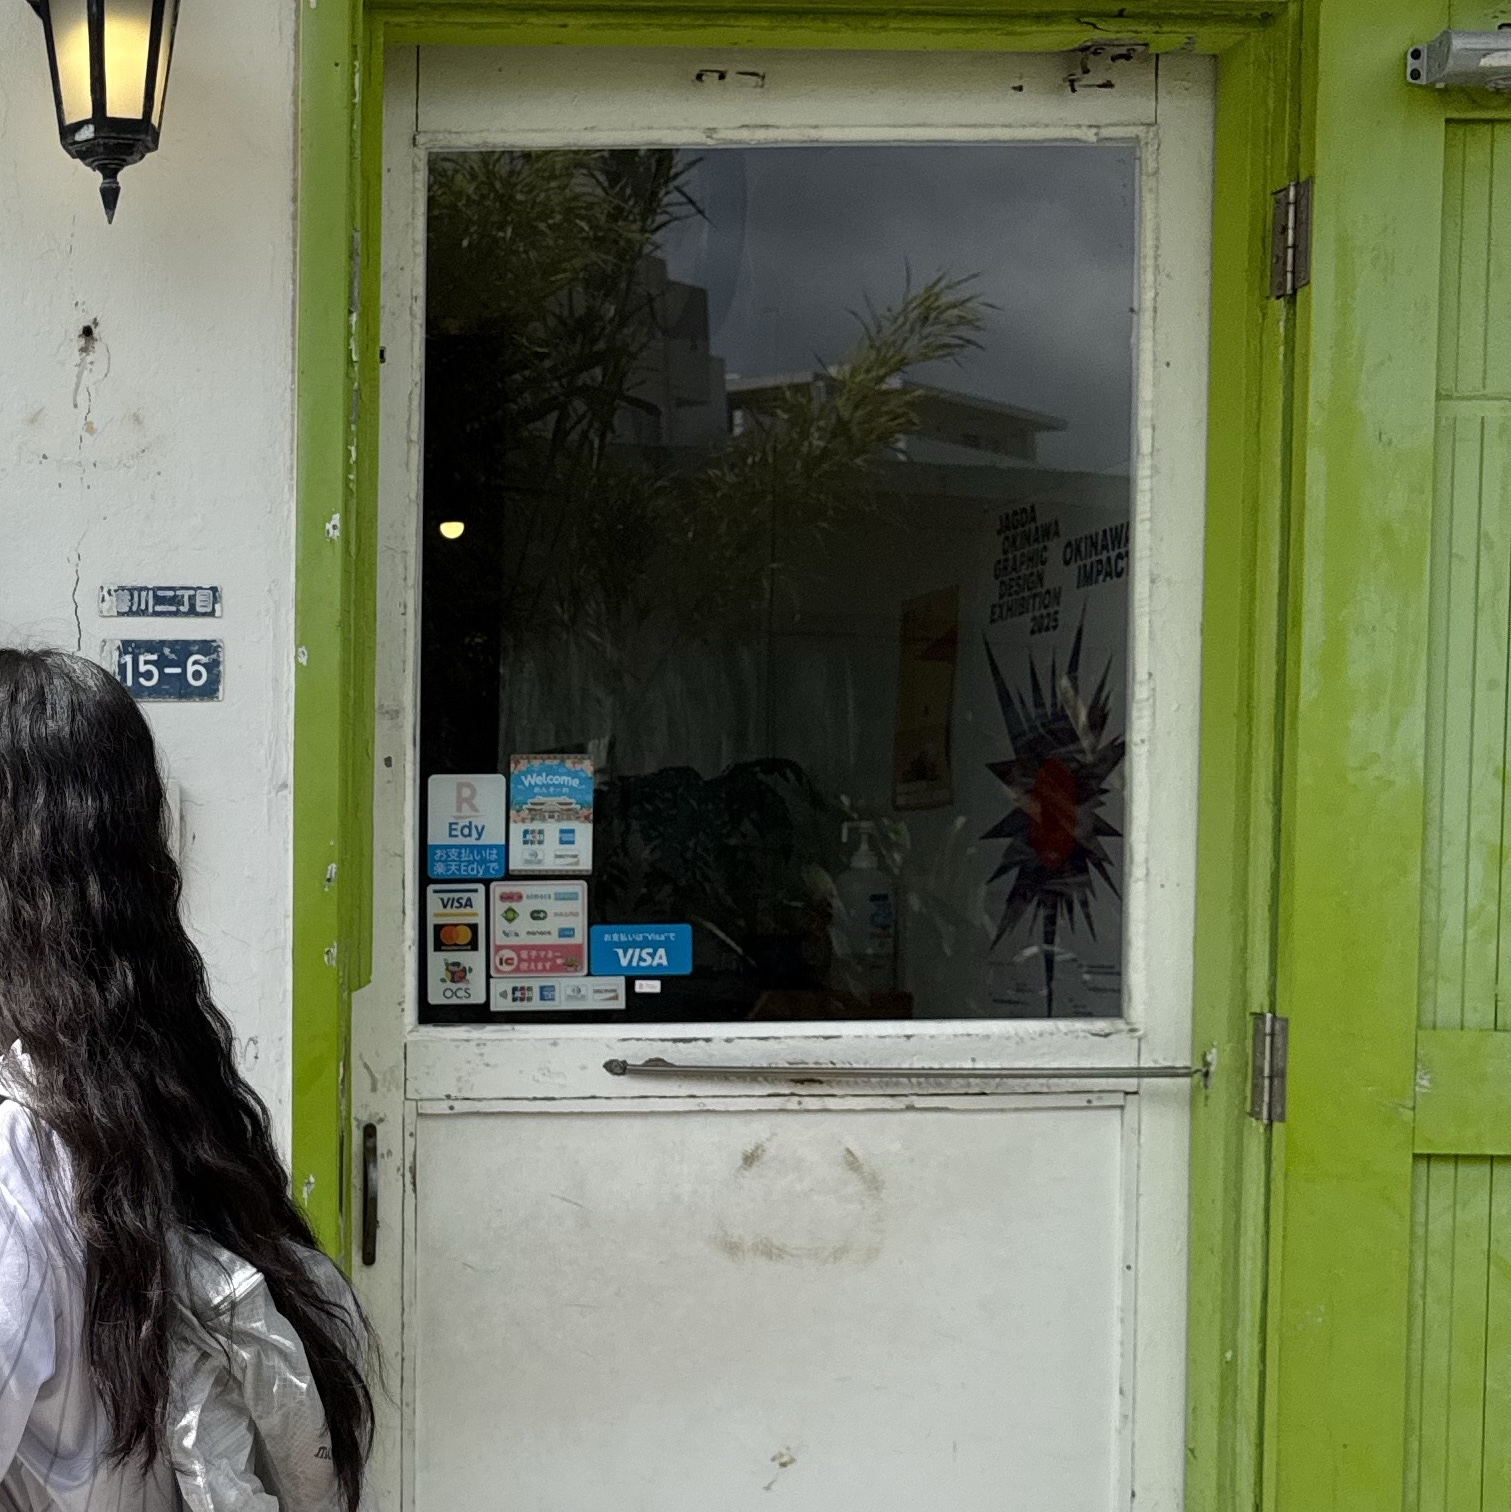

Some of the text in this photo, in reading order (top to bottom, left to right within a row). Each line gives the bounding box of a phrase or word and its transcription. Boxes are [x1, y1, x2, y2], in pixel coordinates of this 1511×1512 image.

[997, 504, 1038, 535] JAGDA
[1002, 518, 1060, 556] OKINAWA
[994, 545, 1048, 580] GRAPHIC
[998, 570, 1045, 600] DESIGN
[989, 586, 1062, 624] EXHIBITION
[1030, 610, 1059, 635] 2025
[121, 653, 209, 687] 15-6
[521, 772, 581, 788] Welcome
[455, 781, 480, 813] R
[448, 821, 486, 841] Edy
[434, 848, 499, 861] お支払いは
[434, 862, 499, 876] 楽天Edyで
[438, 896, 474, 910] VISA
[613, 947, 669, 968] VISA
[442, 987, 472, 1000] OCS
